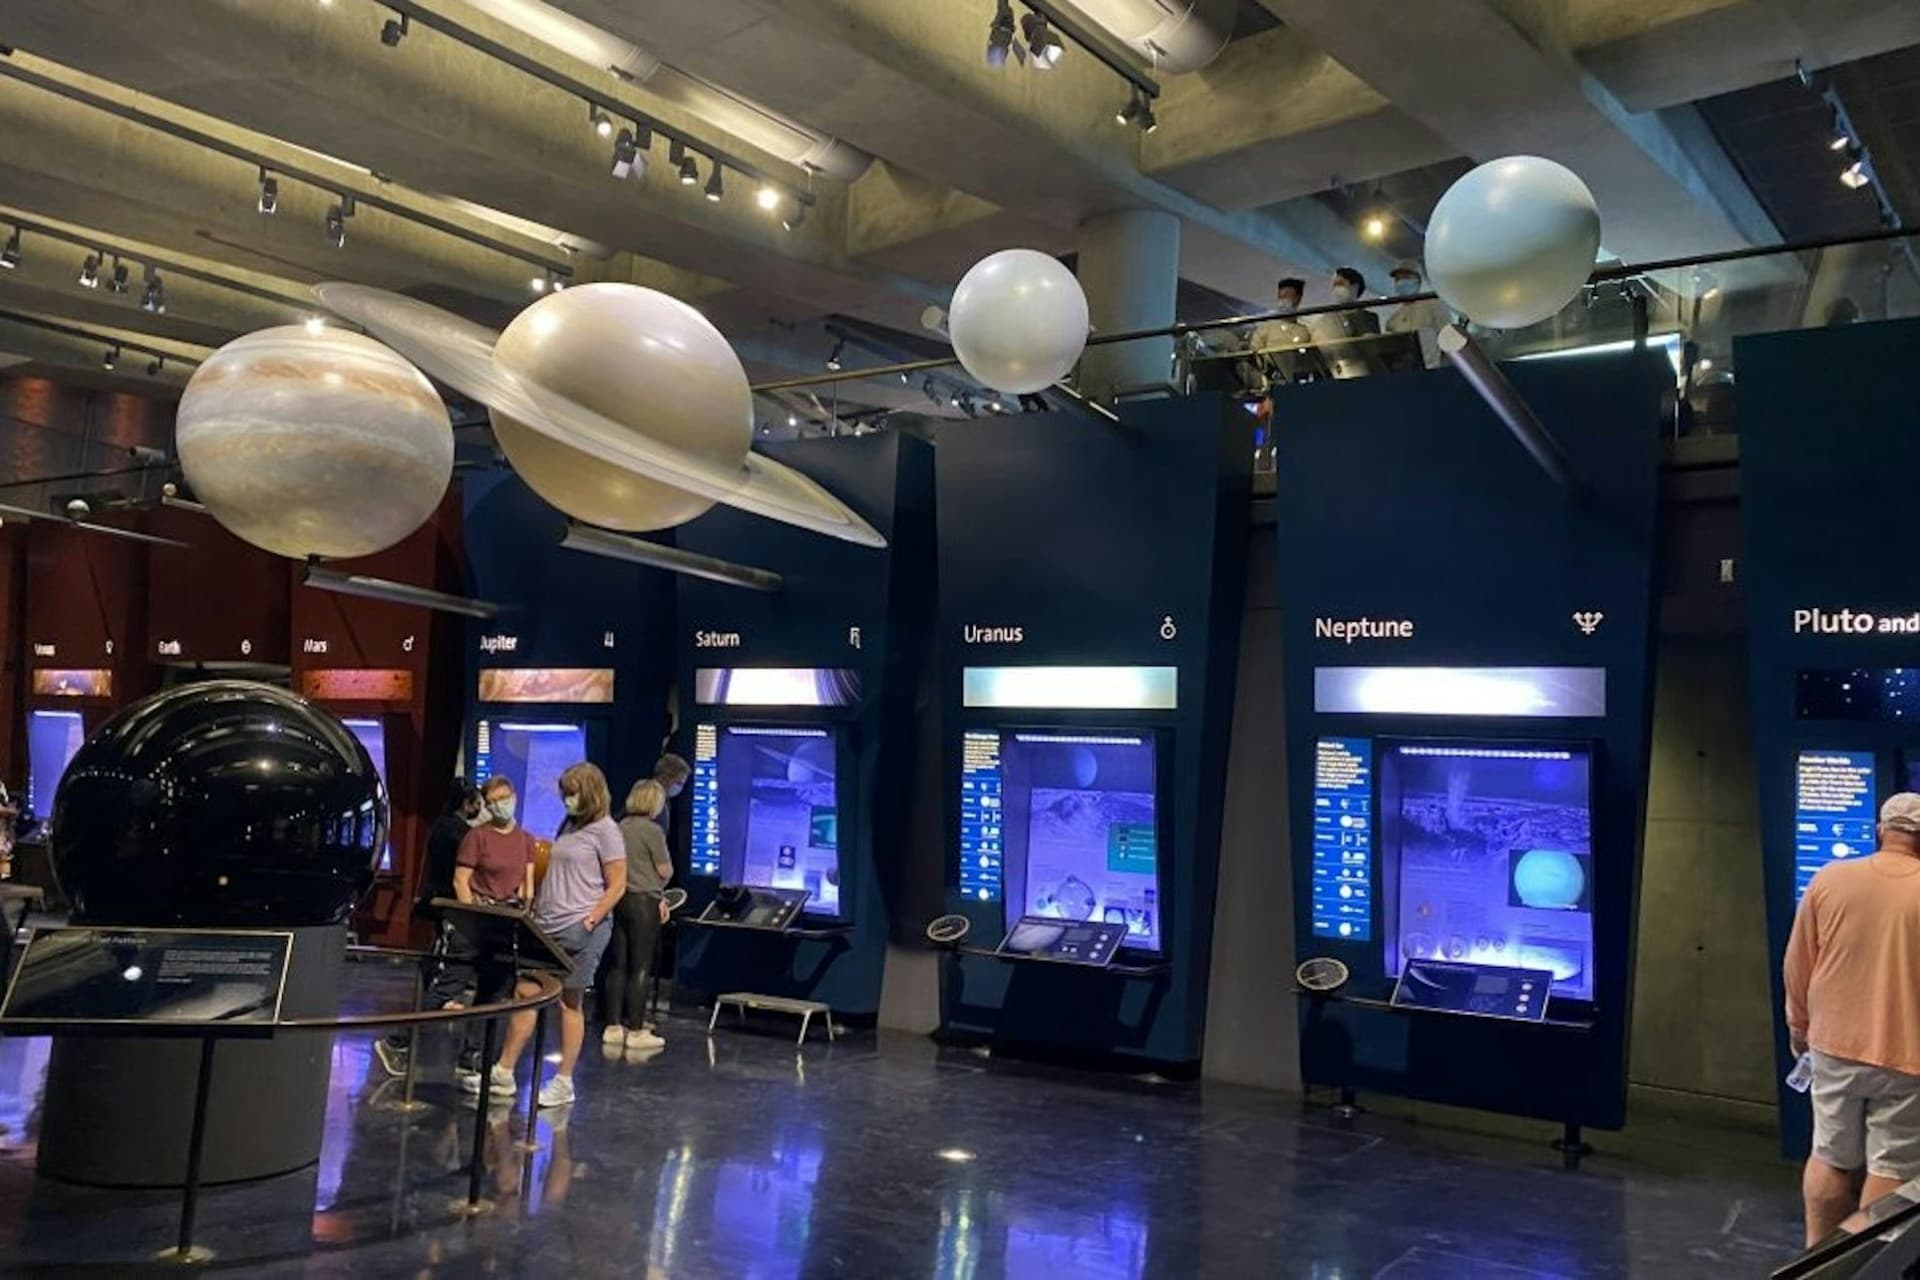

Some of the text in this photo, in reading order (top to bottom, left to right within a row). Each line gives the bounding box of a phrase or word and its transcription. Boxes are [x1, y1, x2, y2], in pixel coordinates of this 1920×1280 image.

[1794, 607, 1920, 634] Pluto and
[695, 630, 741, 647] Saturn
[964, 624, 1024, 643] Uranus
[1315, 616, 1414, 645] Neptune
[303, 638, 328, 653] Mars
[480, 635, 517, 654] Jupiter
